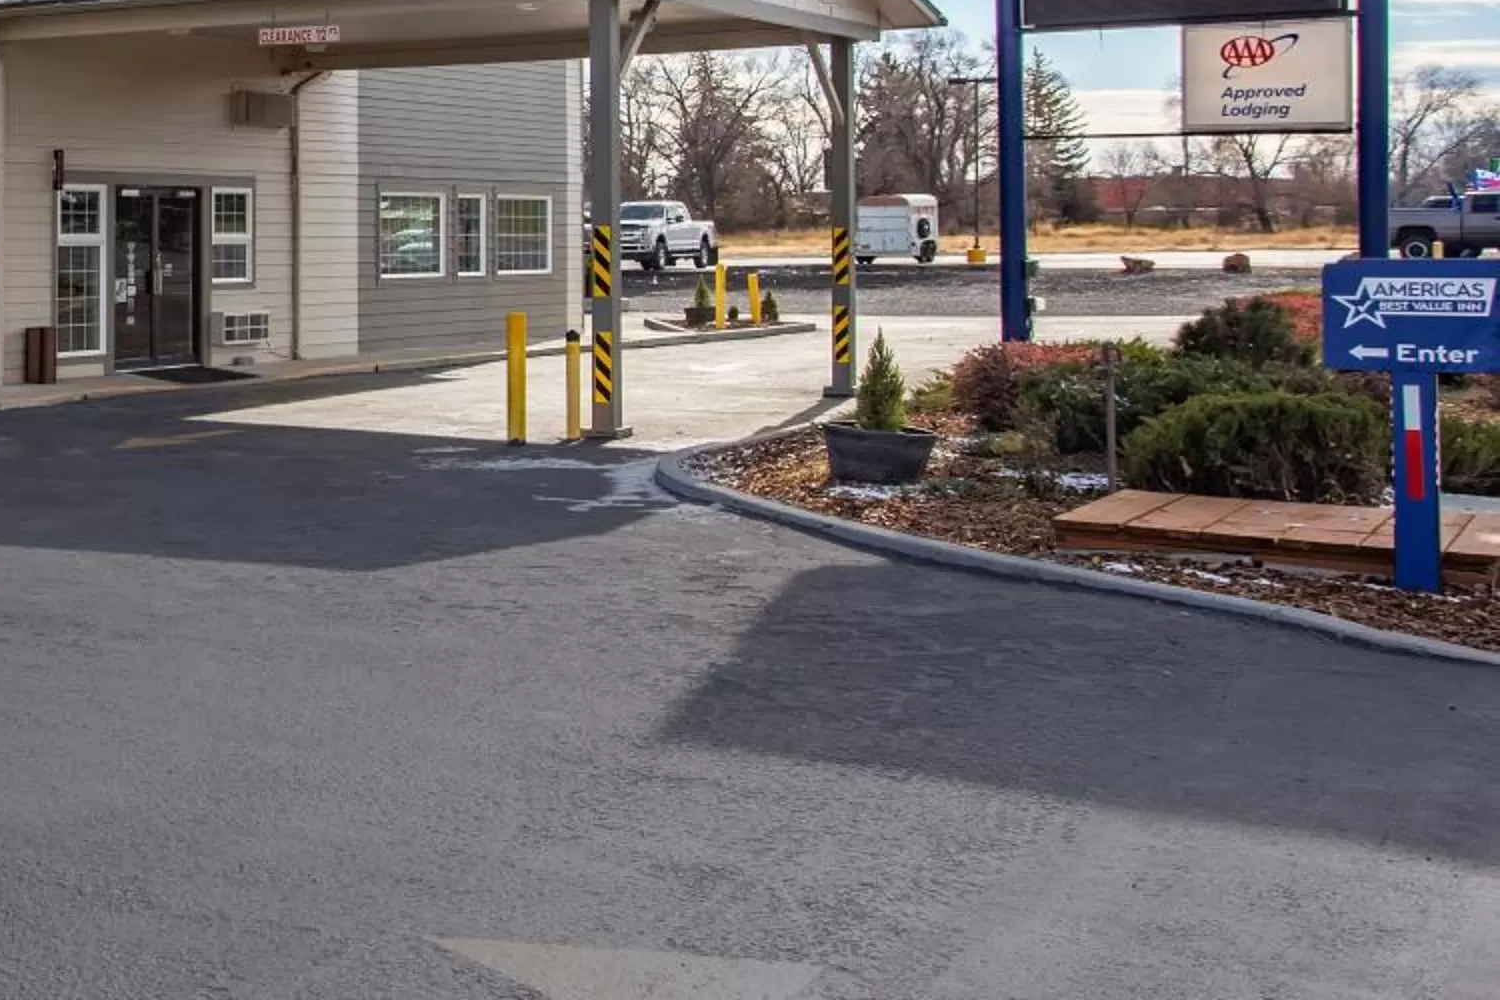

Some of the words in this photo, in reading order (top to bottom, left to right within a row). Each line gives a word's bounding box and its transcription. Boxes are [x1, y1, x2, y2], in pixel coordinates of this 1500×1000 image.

[1226, 37, 1270, 67] AAA
[1221, 83, 1307, 101] Approved
[1221, 104, 1291, 119] Lodging
[1372, 282, 1485, 297] AMERICAS
[1379, 301, 1409, 312] BEST
[1410, 301, 1453, 312] VALUE
[1457, 302, 1483, 313] INN
[1396, 343, 1479, 364] Enter
